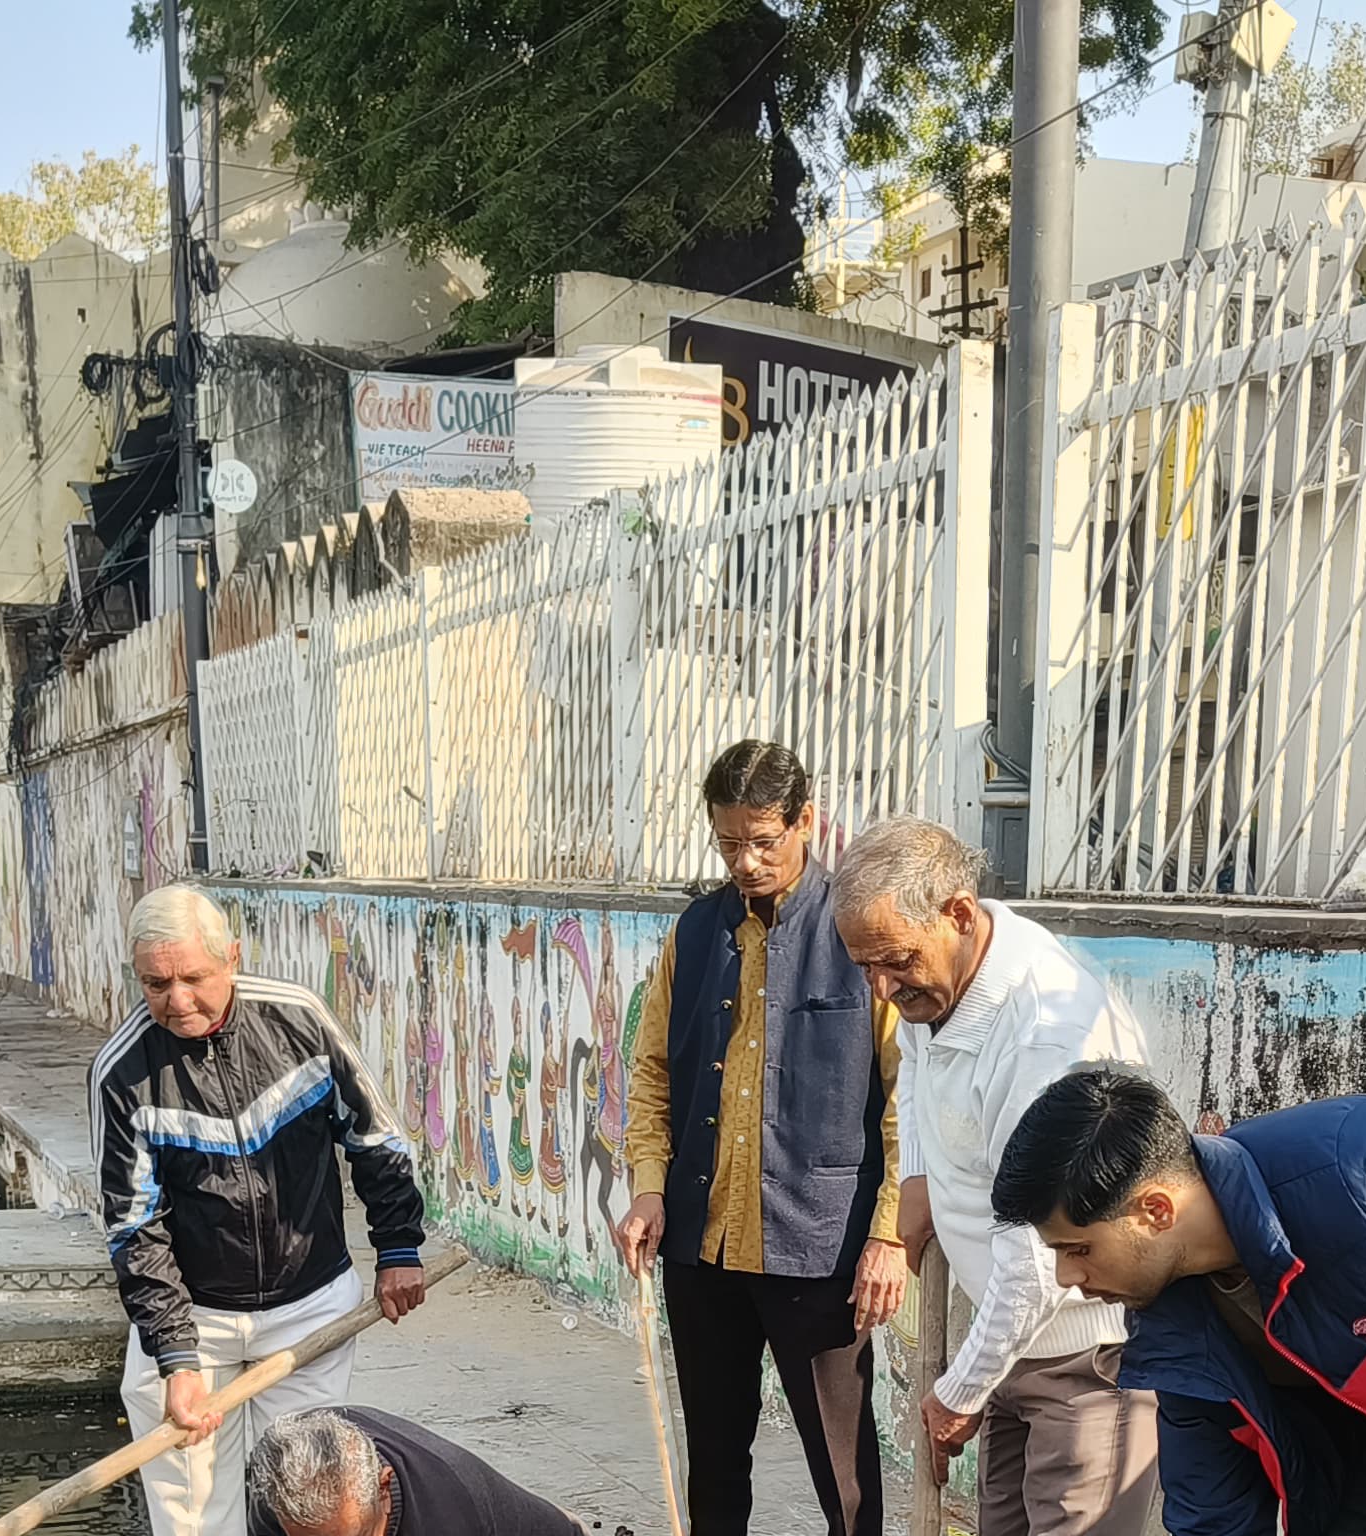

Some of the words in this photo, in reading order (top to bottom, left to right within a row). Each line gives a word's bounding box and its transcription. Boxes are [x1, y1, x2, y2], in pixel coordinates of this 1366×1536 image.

[357, 380, 434, 433] Guddi
[437, 389, 515, 437] COOKI
[387, 444, 427, 457] TEACH
[467, 438, 505, 453] HEENA
